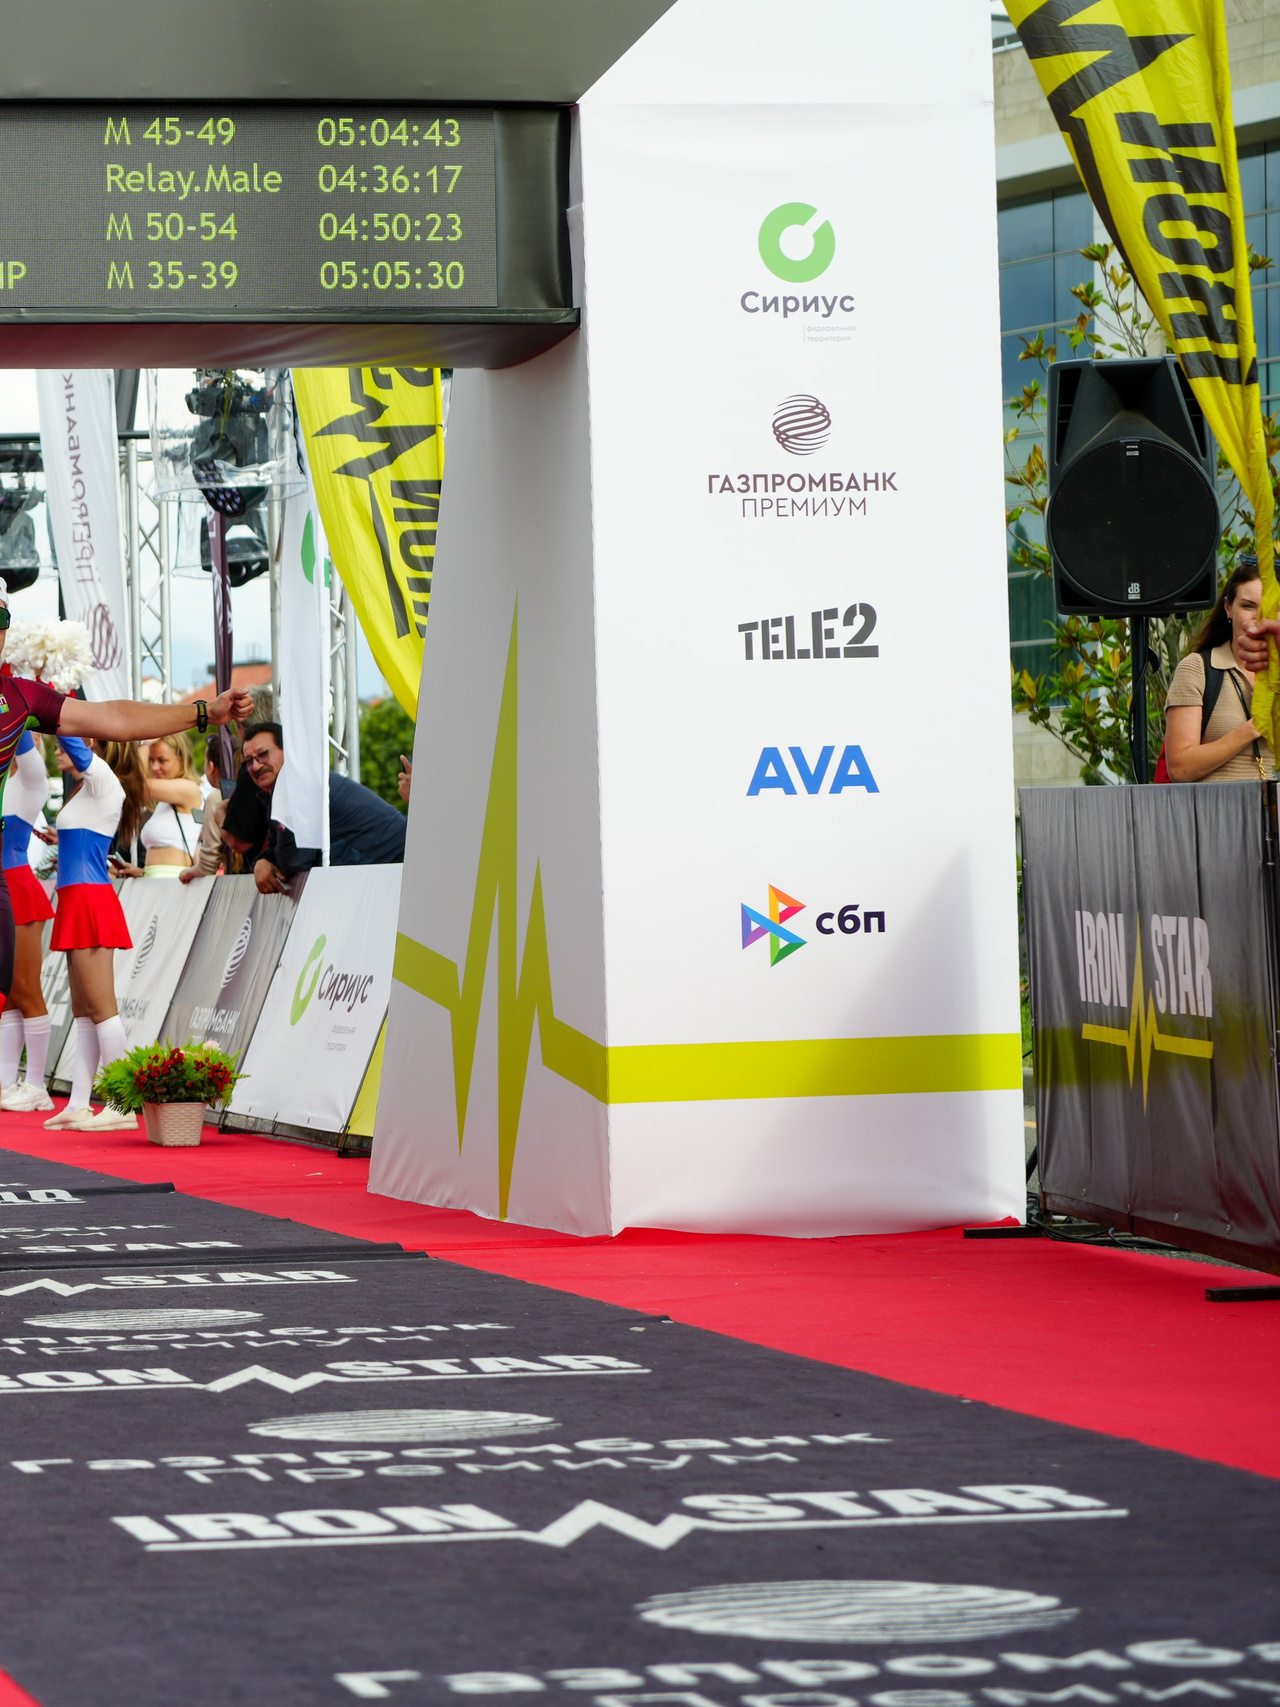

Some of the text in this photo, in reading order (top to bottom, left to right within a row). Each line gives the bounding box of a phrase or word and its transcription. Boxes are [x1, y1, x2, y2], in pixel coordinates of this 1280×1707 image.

[142, 117, 236, 146] 45-49
[317, 118, 462, 147] 05:04:43
[106, 163, 282, 200] Relay.Male
[318, 165, 463, 194] 04:36:17
[146, 213, 238, 242] 50-54
[319, 213, 464, 242] 04:50:23
[147, 261, 238, 290] 35-39
[320, 261, 466, 290] 05:05:30
[740, 291, 855, 318] Сириус
[806, 324, 857, 334] федеральная
[707, 472, 898, 494] ГАЗПРОМБАНК
[742, 497, 867, 517] ПРЕМИУМ
[1128, 583, 1140, 594] dB
[738, 602, 880, 661] TELE2
[746, 745, 880, 796] AVA
[816, 904, 886, 935] сбп
[1075, 910, 1213, 1018] IRON STAR
[318, 964, 374, 1013] Сириус
[19, 1241, 243, 1254] STAR
[101, 1270, 343, 1286] STAR
[325, 1355, 642, 1377] STAR
[10, 1432, 893, 1475] Газпромбанк
[183, 1451, 801, 1484] Премиум
[112, 1484, 1110, 1542] IRON STAR
[335, 1638, 1280, 1699] Газпромб
